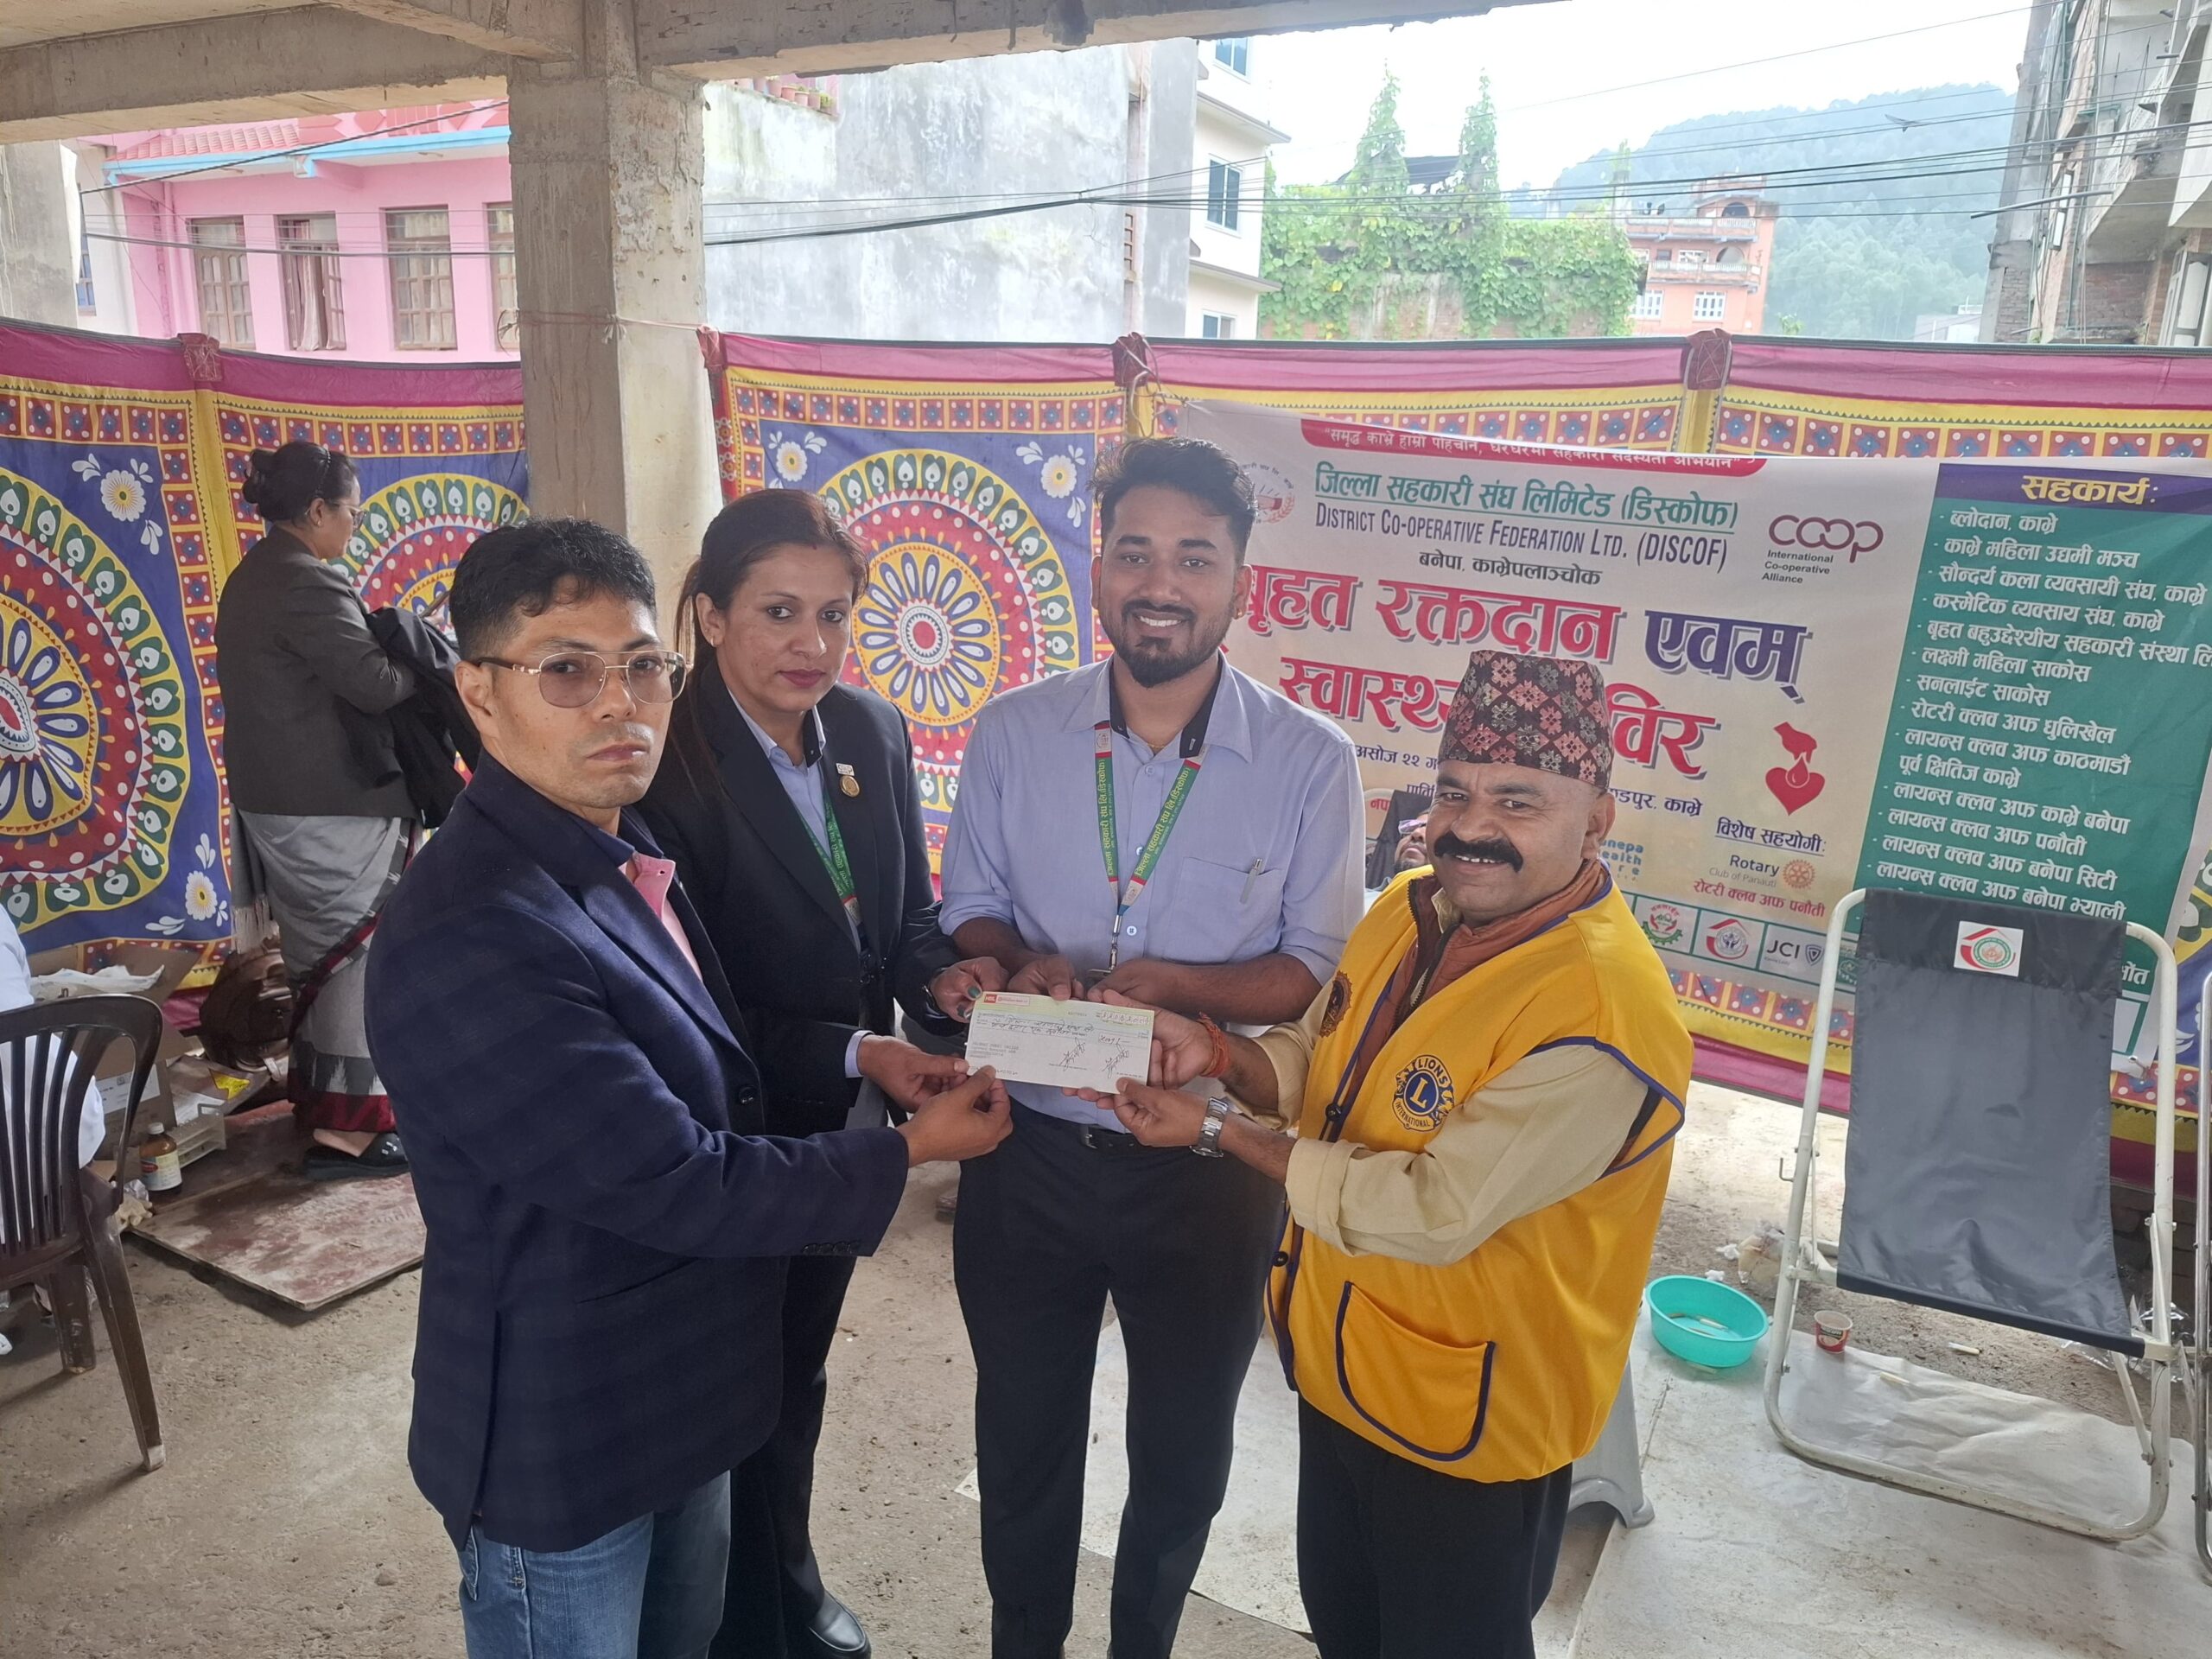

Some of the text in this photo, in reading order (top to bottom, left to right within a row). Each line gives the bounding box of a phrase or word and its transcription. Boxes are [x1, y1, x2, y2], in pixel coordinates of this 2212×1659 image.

[1315, 461, 1382, 498] जिल्ला
[1386, 474, 1474, 507] सहकारी
[1478, 480, 1518, 510] संघ
[1522, 479, 1615, 518] लिमिटेड
[1622, 486, 1738, 529] (डिस्कोफ)
[1316, 502, 1376, 532] DISTRICT
[1489, 520, 1585, 554] FEDERATION
[1637, 531, 1727, 574] (DISCOF)
[2018, 512, 2058, 535] काभ्रे
[1764, 562, 1830, 575] Co-operative
[1767, 550, 1834, 563] International
[1944, 536, 2140, 569] काभ्रे महिला उद्यमी मञ्च
[1761, 572, 1803, 584] Alliance
[1939, 561, 1997, 585] सौन्दर्य
[1999, 571, 2042, 589] कला
[2044, 575, 2120, 597] व्यवसायी
[2164, 582, 2208, 606] काभ्रे
[1933, 591, 2009, 613] कस्मेटिक
[2012, 601, 2081, 622] व्यवसाय
[2123, 609, 2165, 632] काभ्रे
[1375, 579, 1625, 663] रक्तदान
[1644, 610, 1811, 702] एवम्
[1927, 620, 1964, 640] बृहत
[2063, 634, 2135, 658] सहकारी
[2139, 641, 2190, 664] संस्था
[1922, 646, 2092, 683] लक्ष्मी महिला साकोस
[1916, 674, 2051, 706] सनलाईट साकोस
[1911, 697, 1956, 721] रोटरी
[2002, 713, 2040, 733] अफ
[2043, 716, 2117, 744] धुलिखेल
[1355, 744, 1398, 763] असोज
[1402, 753, 1420, 767] २२
[1904, 728, 1965, 752] लायन्स
[2012, 743, 2050, 763] अफ
[2053, 753, 2132, 775] काठमाडौं
[1899, 753, 2021, 789] पूर्व क्षितिज काभ्रे
[1664, 798, 1703, 817] काभ्रे
[1893, 781, 1953, 805] लायन्स
[1999, 798, 2038, 818] अफ
[2040, 805, 2081, 827] काभ्रे
[2083, 810, 2131, 835] बनेपा
[1717, 817, 1757, 840] विशेष
[1888, 808, 1948, 832] लायन्स
[1993, 826, 2031, 845] अफ
[1602, 850, 1641, 866] ealth
[1603, 839, 1643, 854] nepa
[1709, 867, 1729, 878] Club
[1731, 872, 1741, 881] of
[1730, 854, 1780, 877] Rotary
[1882, 835, 1942, 859] लायन्स
[1987, 853, 2025, 873] अफ
[2028, 859, 2074, 883] बनेपा
[2076, 864, 2118, 891] सिटी
[1694, 879, 1726, 897] रोटरी
[1759, 893, 1786, 908] अफ
[1877, 861, 1936, 886] लायन्स
[1981, 880, 2019, 900] अफ
[2022, 887, 2068, 910] बनेपा
[1767, 940, 1800, 959] JCI
[1418, 1058, 1448, 1085] LIONS
[1409, 1077, 1428, 1109] L
[1395, 1101, 1431, 1128] INTERNATIONAL
